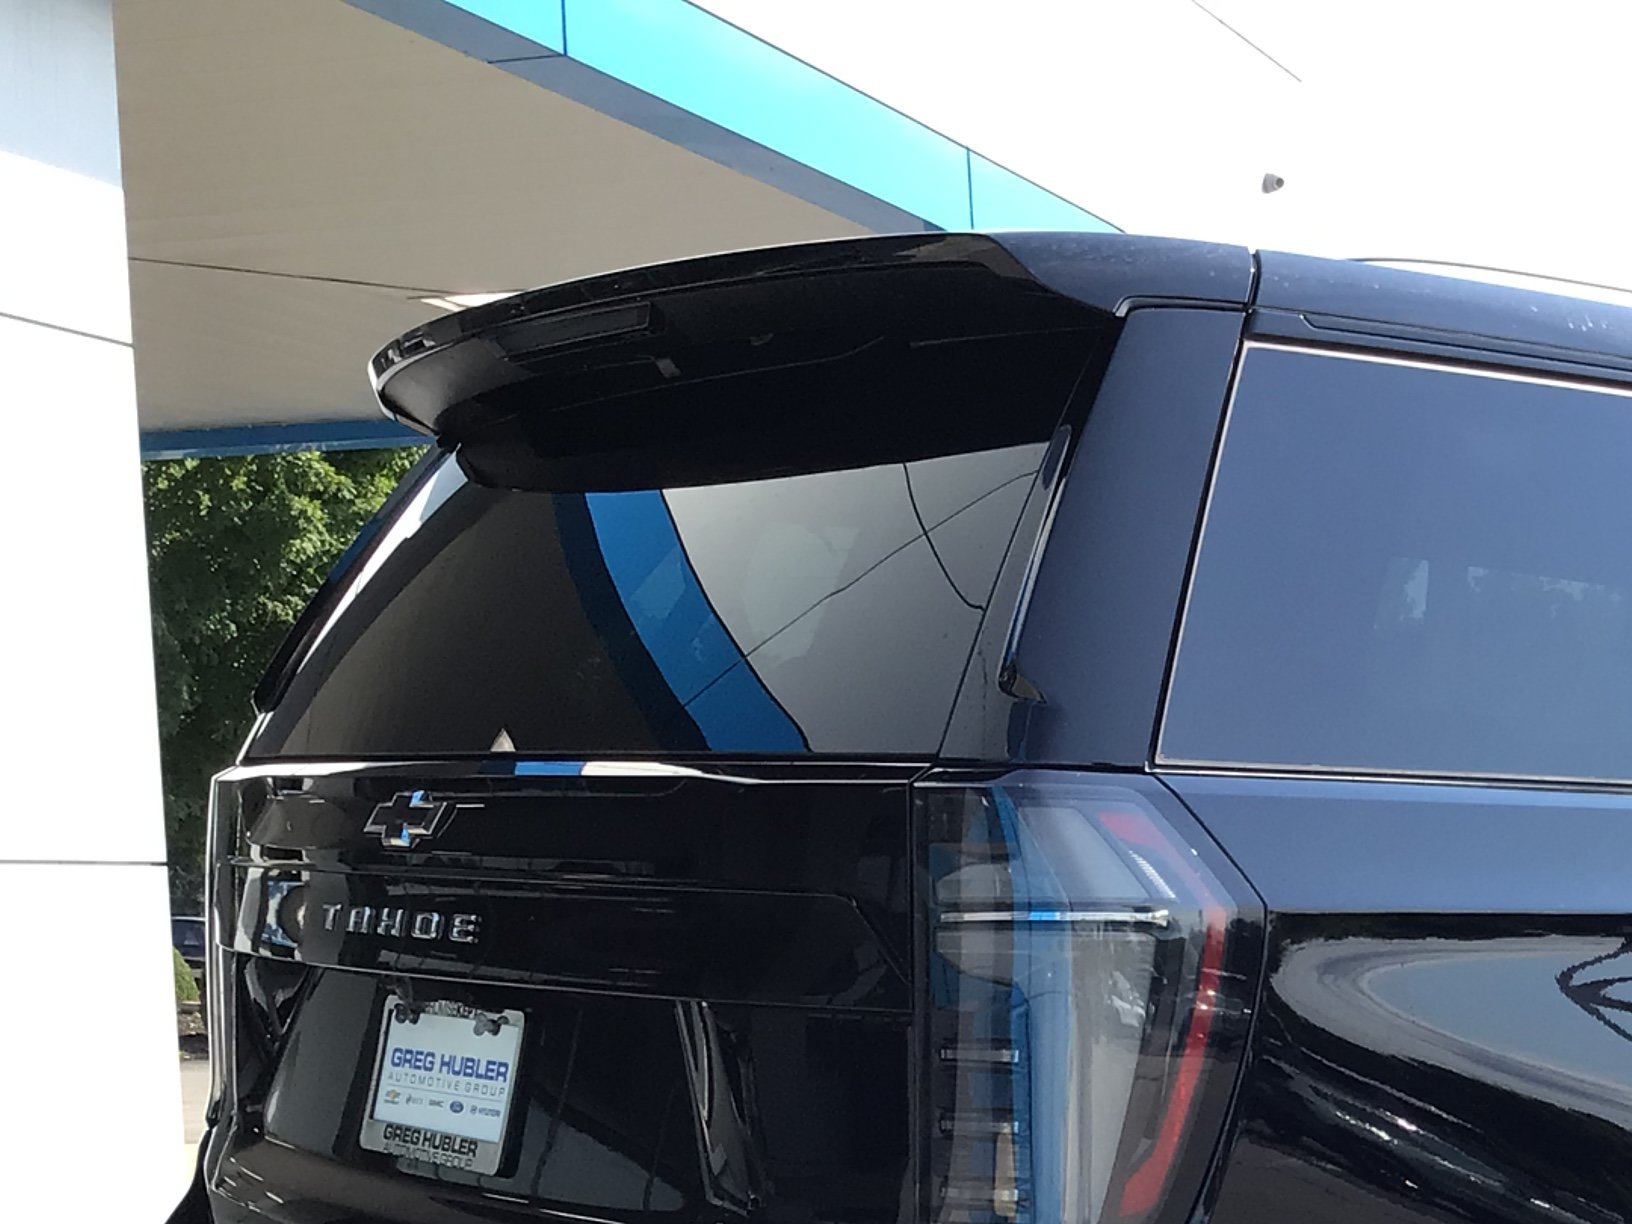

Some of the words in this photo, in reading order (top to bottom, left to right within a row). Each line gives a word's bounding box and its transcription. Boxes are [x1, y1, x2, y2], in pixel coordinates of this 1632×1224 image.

[323, 903, 481, 944] TAHOE
[390, 1046, 437, 1073] GREG
[438, 1053, 510, 1084] HUBLER
[387, 1072, 461, 1092] AUTOMOTIVE
[464, 1082, 506, 1098] GROUP
[383, 1122, 422, 1146] GREG
[421, 1131, 479, 1159] HUBLER
